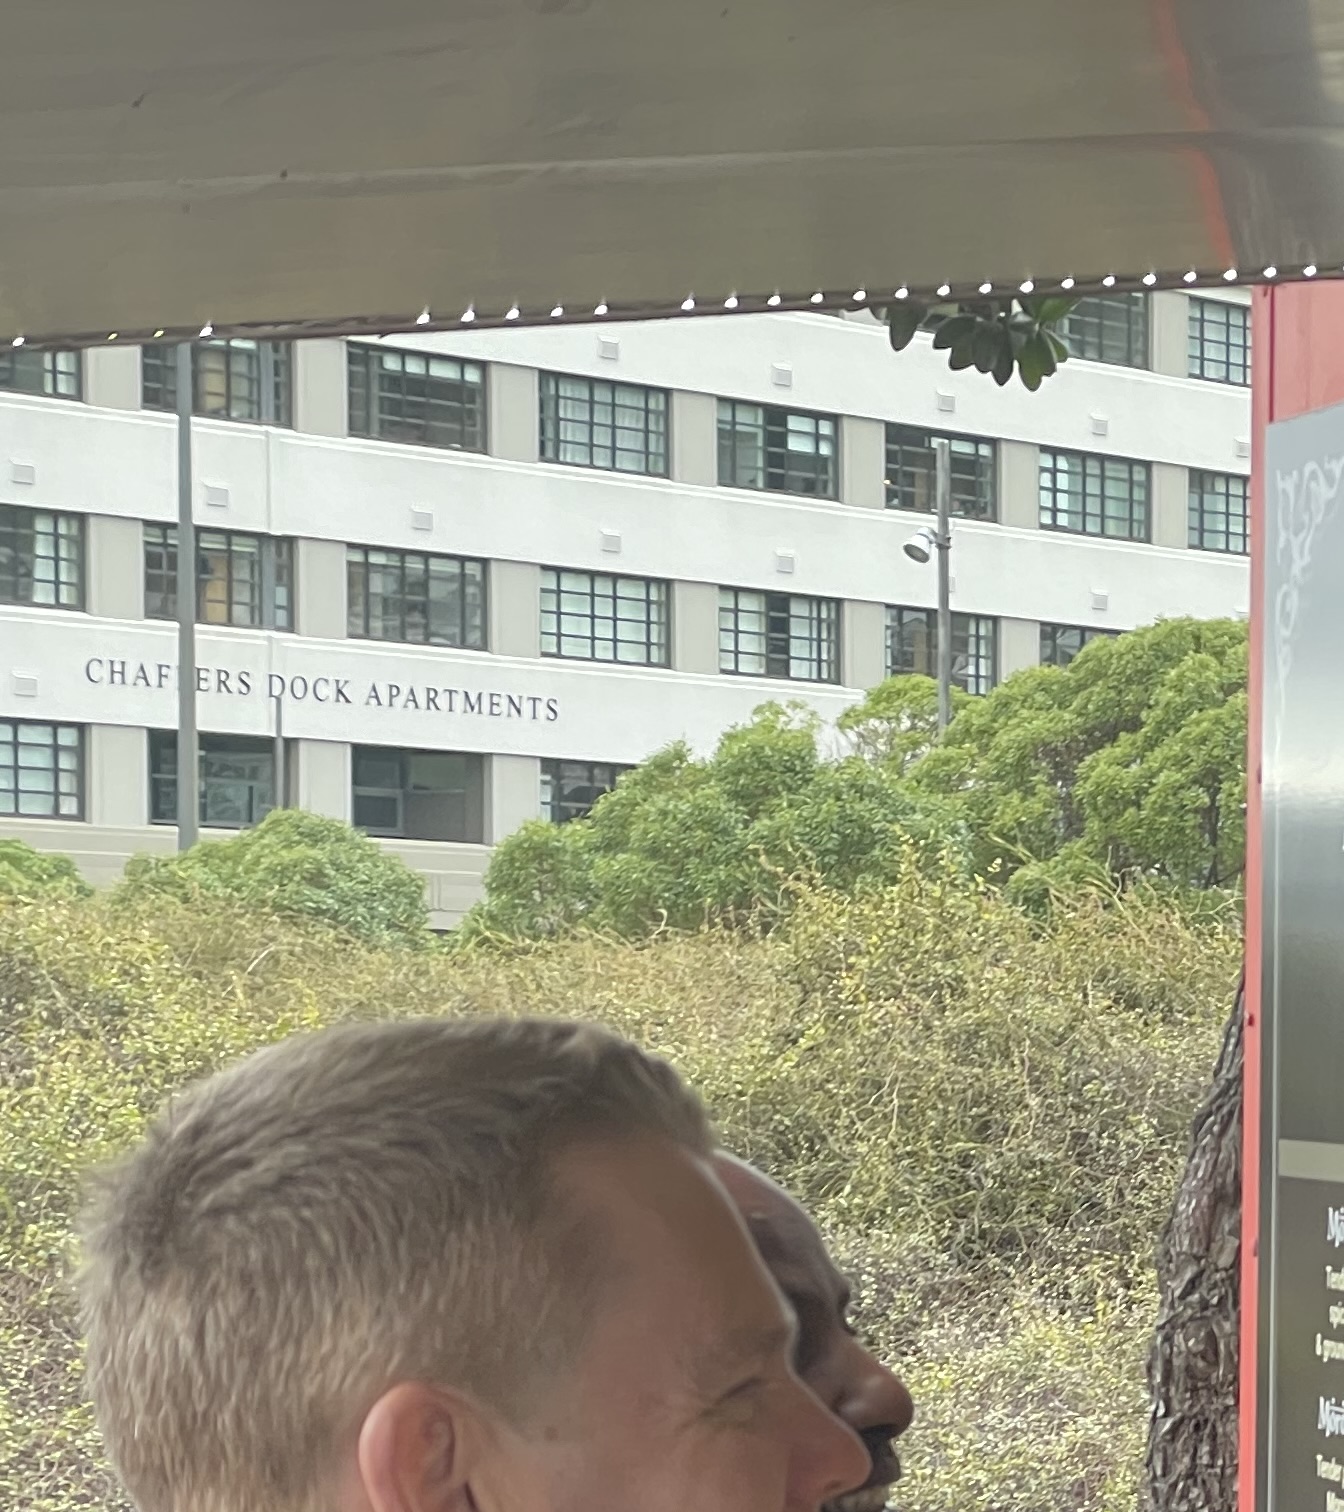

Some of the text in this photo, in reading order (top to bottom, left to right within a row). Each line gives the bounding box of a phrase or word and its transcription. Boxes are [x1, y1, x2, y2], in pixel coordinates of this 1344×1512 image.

[86, 658, 559, 722] CHAFERS DOCK APARTMENTS
[1315, 1333, 1322, 1356] &
[1316, 1454, 1342, 1482] Tender
